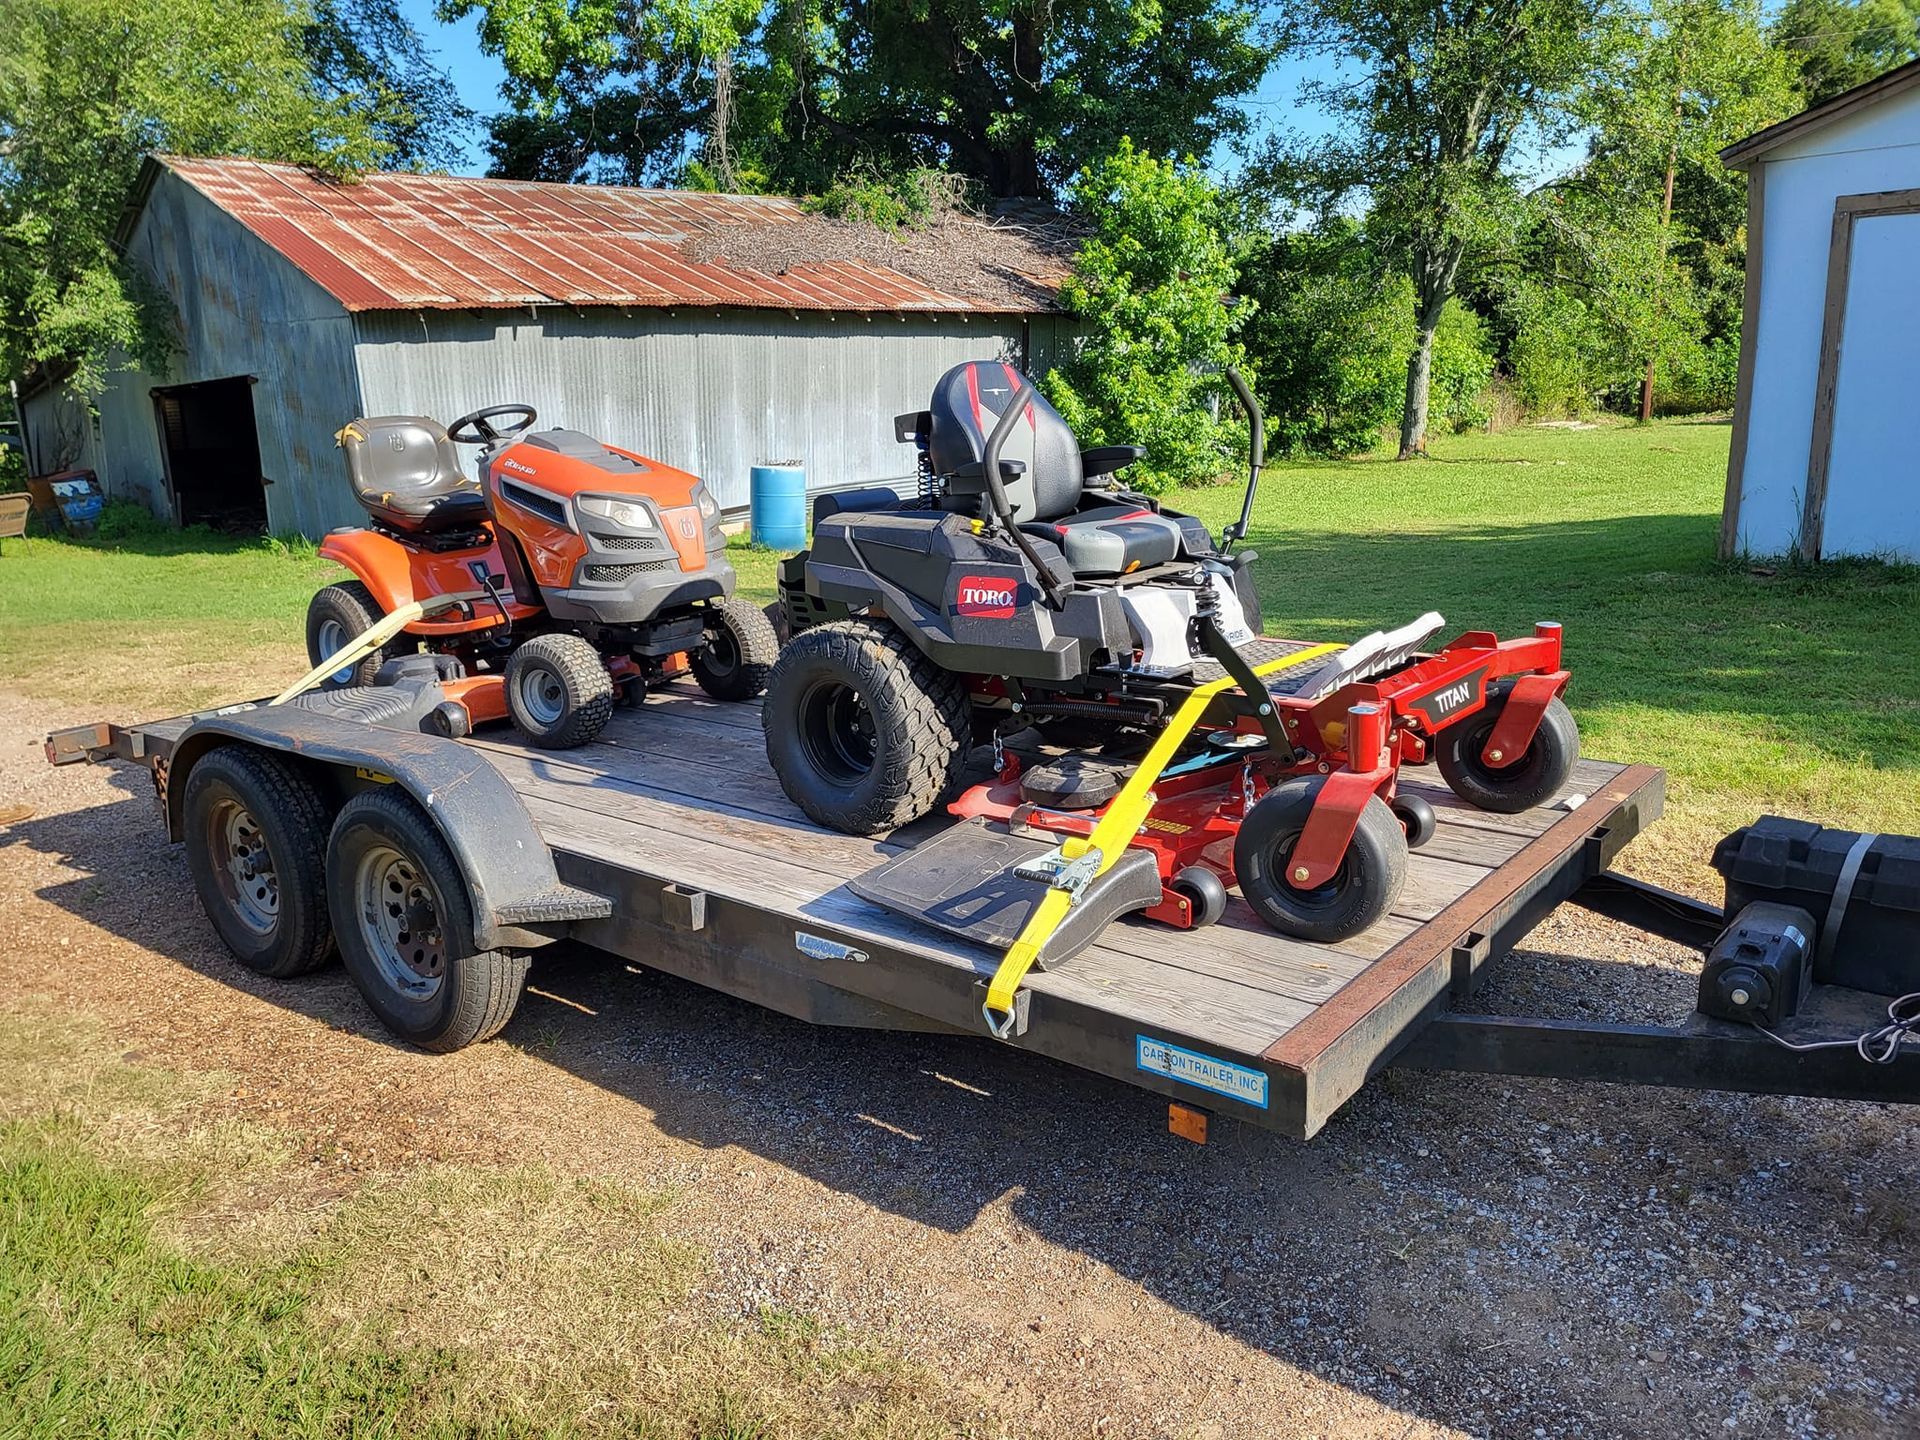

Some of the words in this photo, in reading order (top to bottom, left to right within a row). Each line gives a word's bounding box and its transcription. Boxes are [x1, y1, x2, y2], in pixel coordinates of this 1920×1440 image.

[963, 588, 1013, 606] TORO
[1434, 681, 1470, 714] TITAN
[1142, 1045, 1186, 1069] CARON
[1239, 1078, 1262, 1093] INC.
